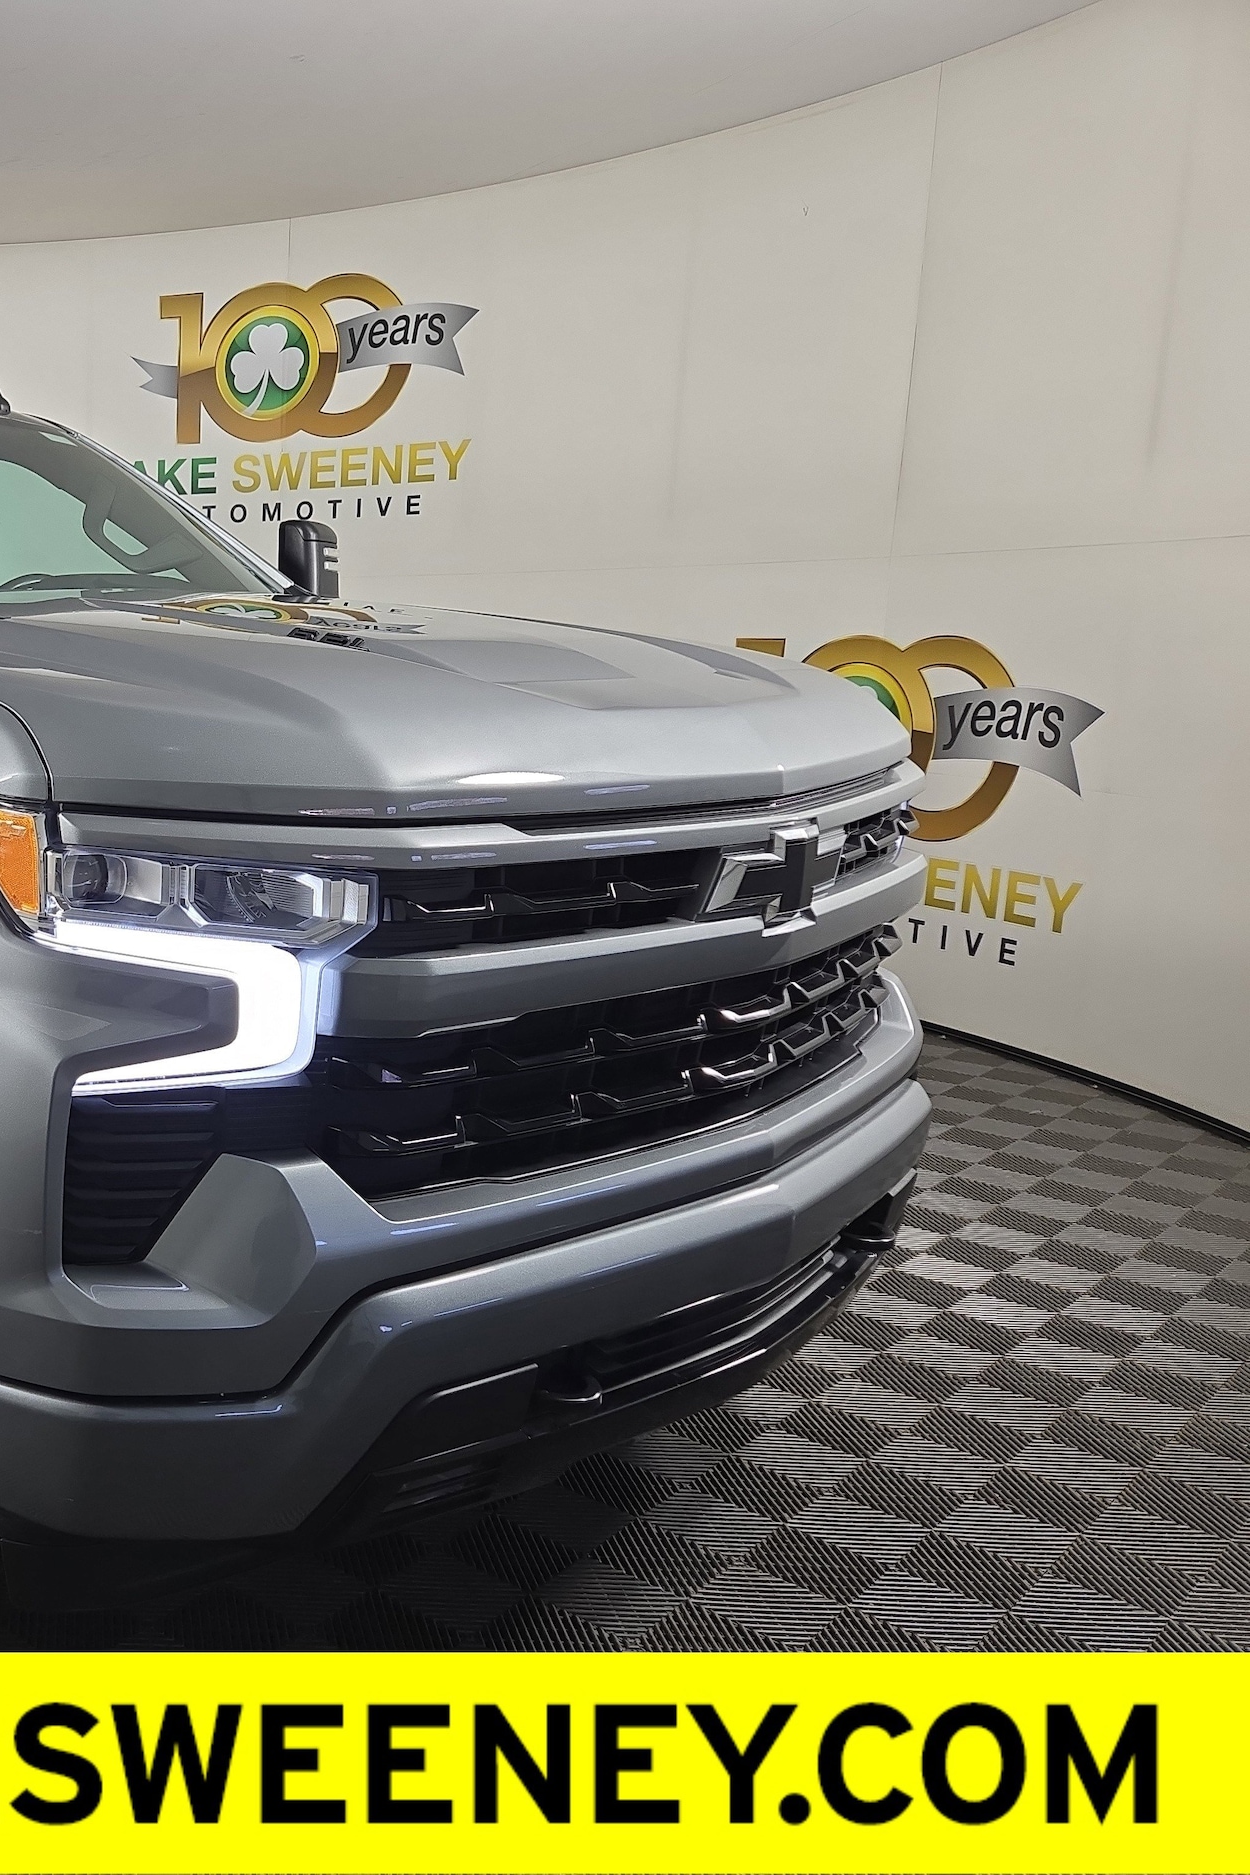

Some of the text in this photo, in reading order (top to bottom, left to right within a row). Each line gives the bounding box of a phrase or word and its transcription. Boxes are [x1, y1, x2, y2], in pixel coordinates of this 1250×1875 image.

[346, 309, 446, 364] years
[232, 439, 472, 493] SWEENEY
[202, 494, 421, 523] TOMOTIVE
[942, 698, 1066, 751] years
[924, 857, 1084, 934] ENEY
